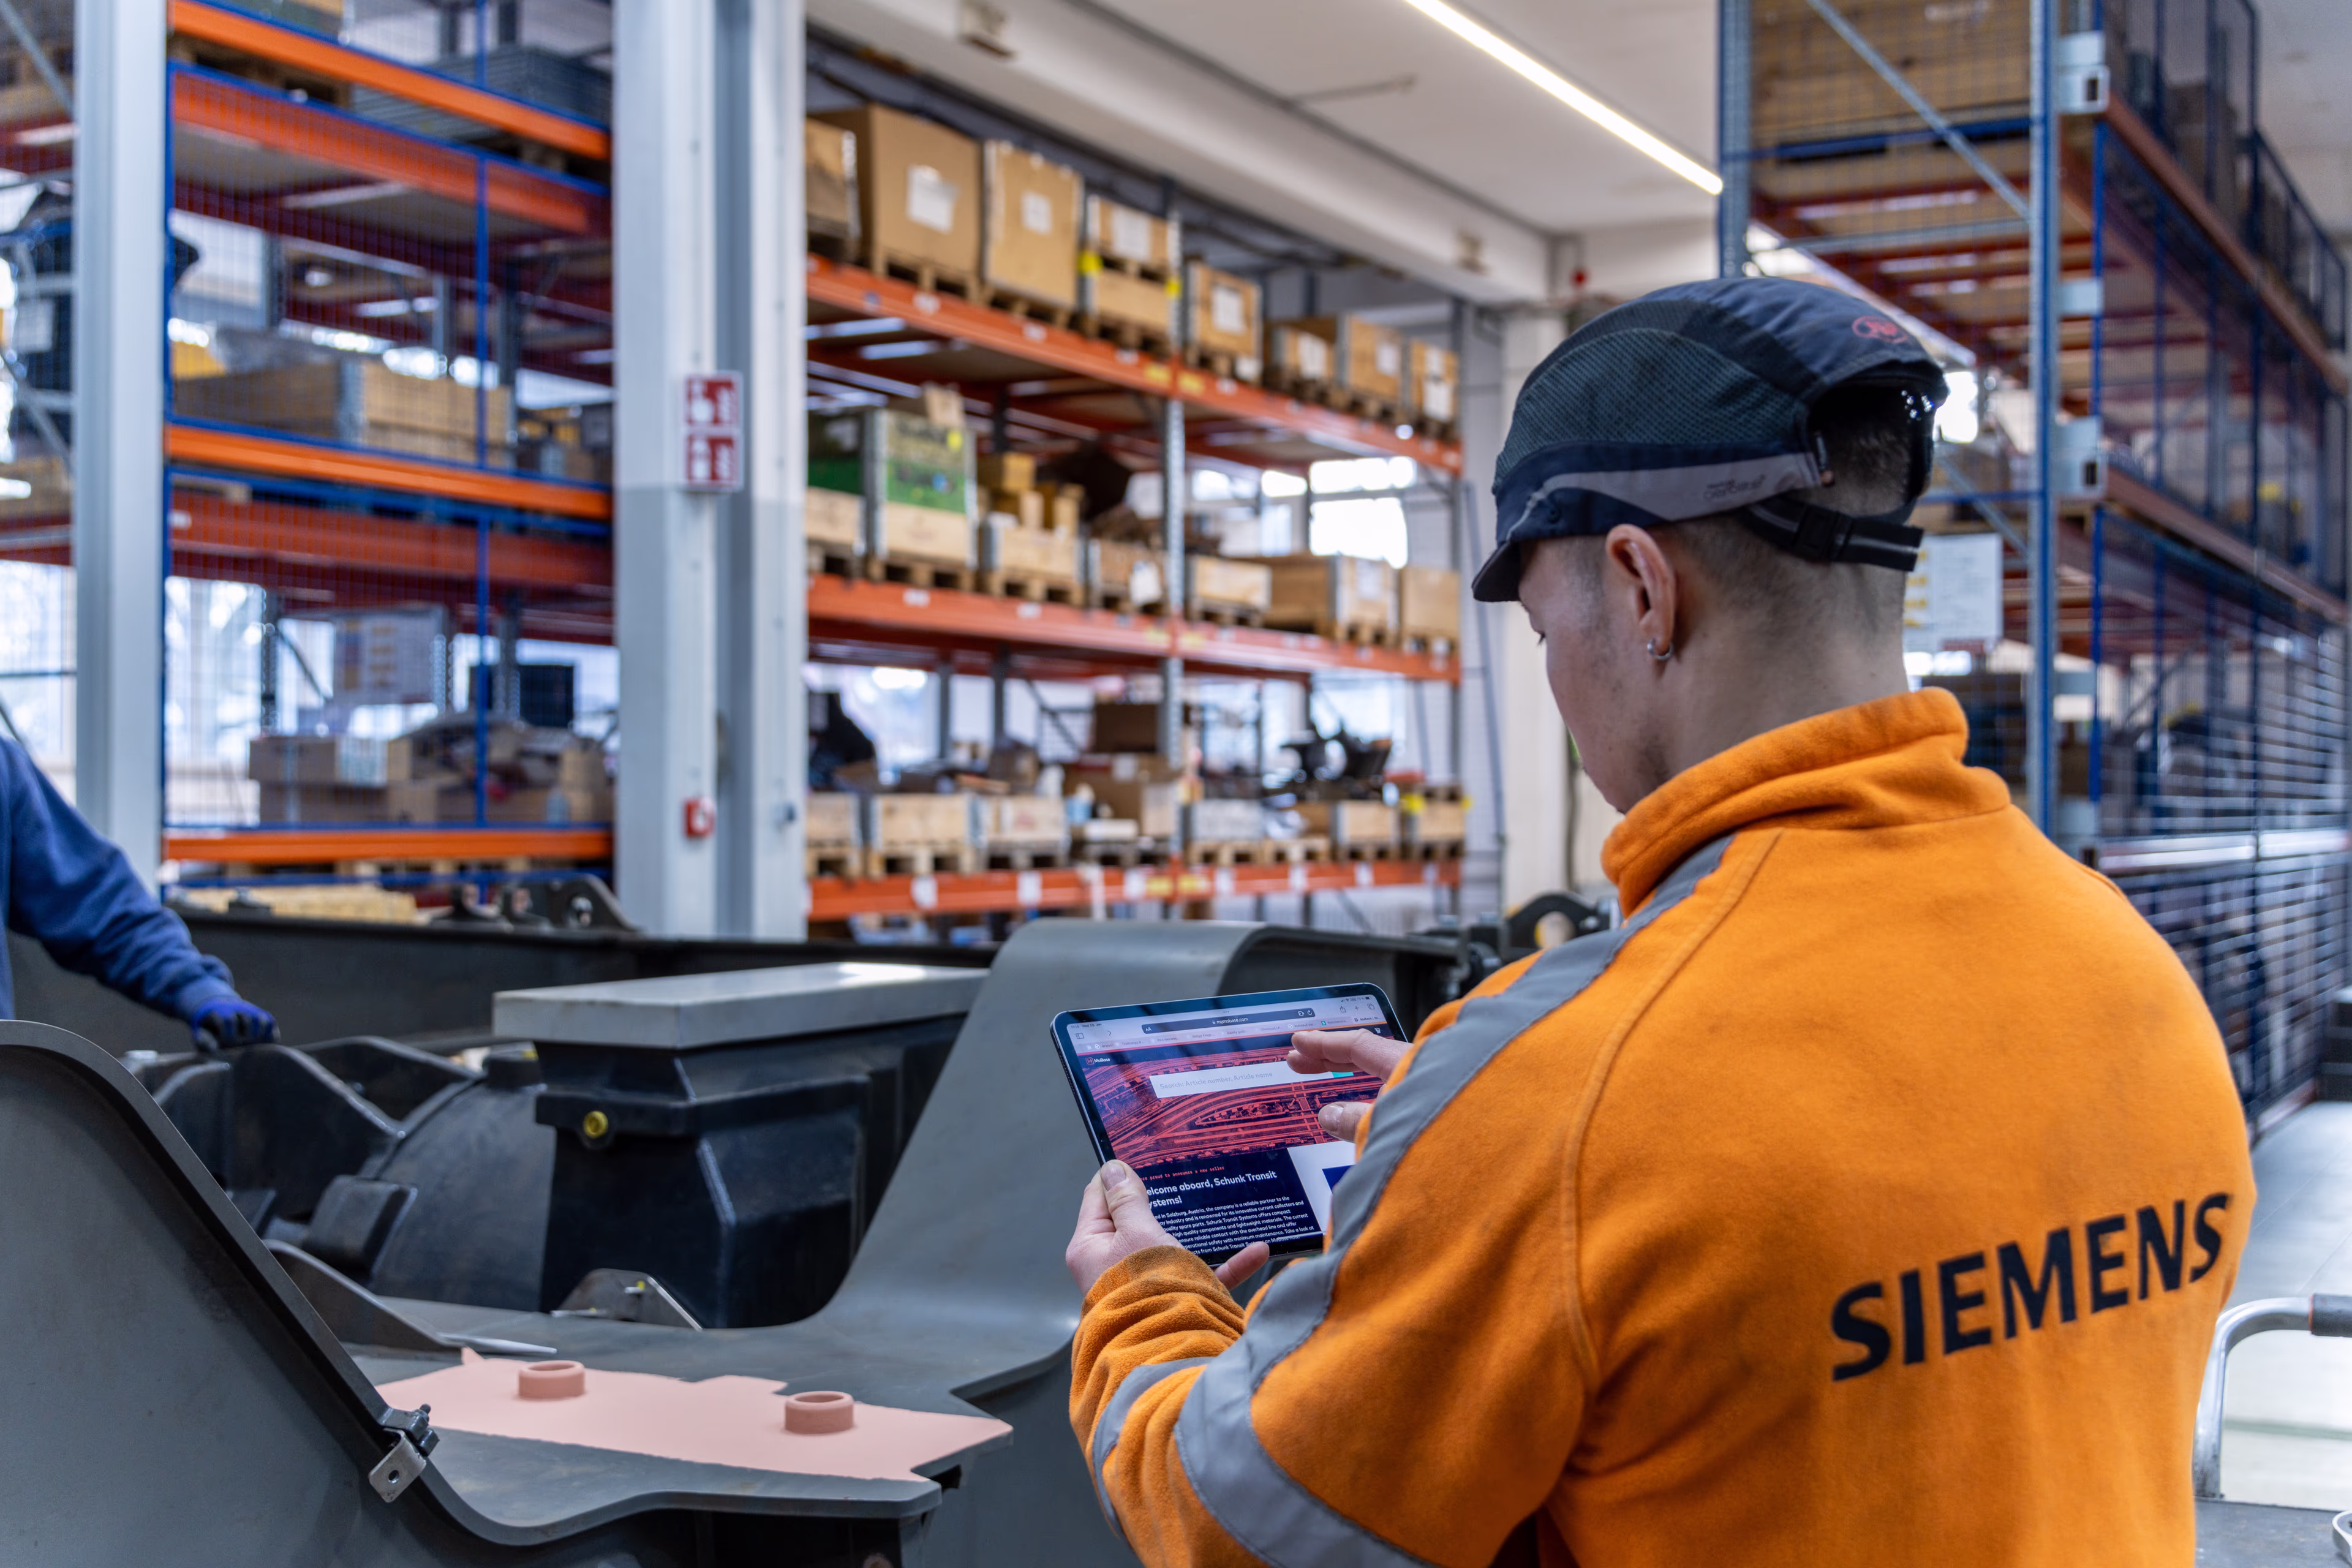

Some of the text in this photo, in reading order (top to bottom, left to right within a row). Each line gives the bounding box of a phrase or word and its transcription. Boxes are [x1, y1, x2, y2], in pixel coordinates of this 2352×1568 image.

[1147, 1170, 1277, 1196] elcome aboard, Schunk Transit
[1148, 1195, 1182, 1209] ystems!
[1830, 1192, 2233, 1382] SIEMENS
